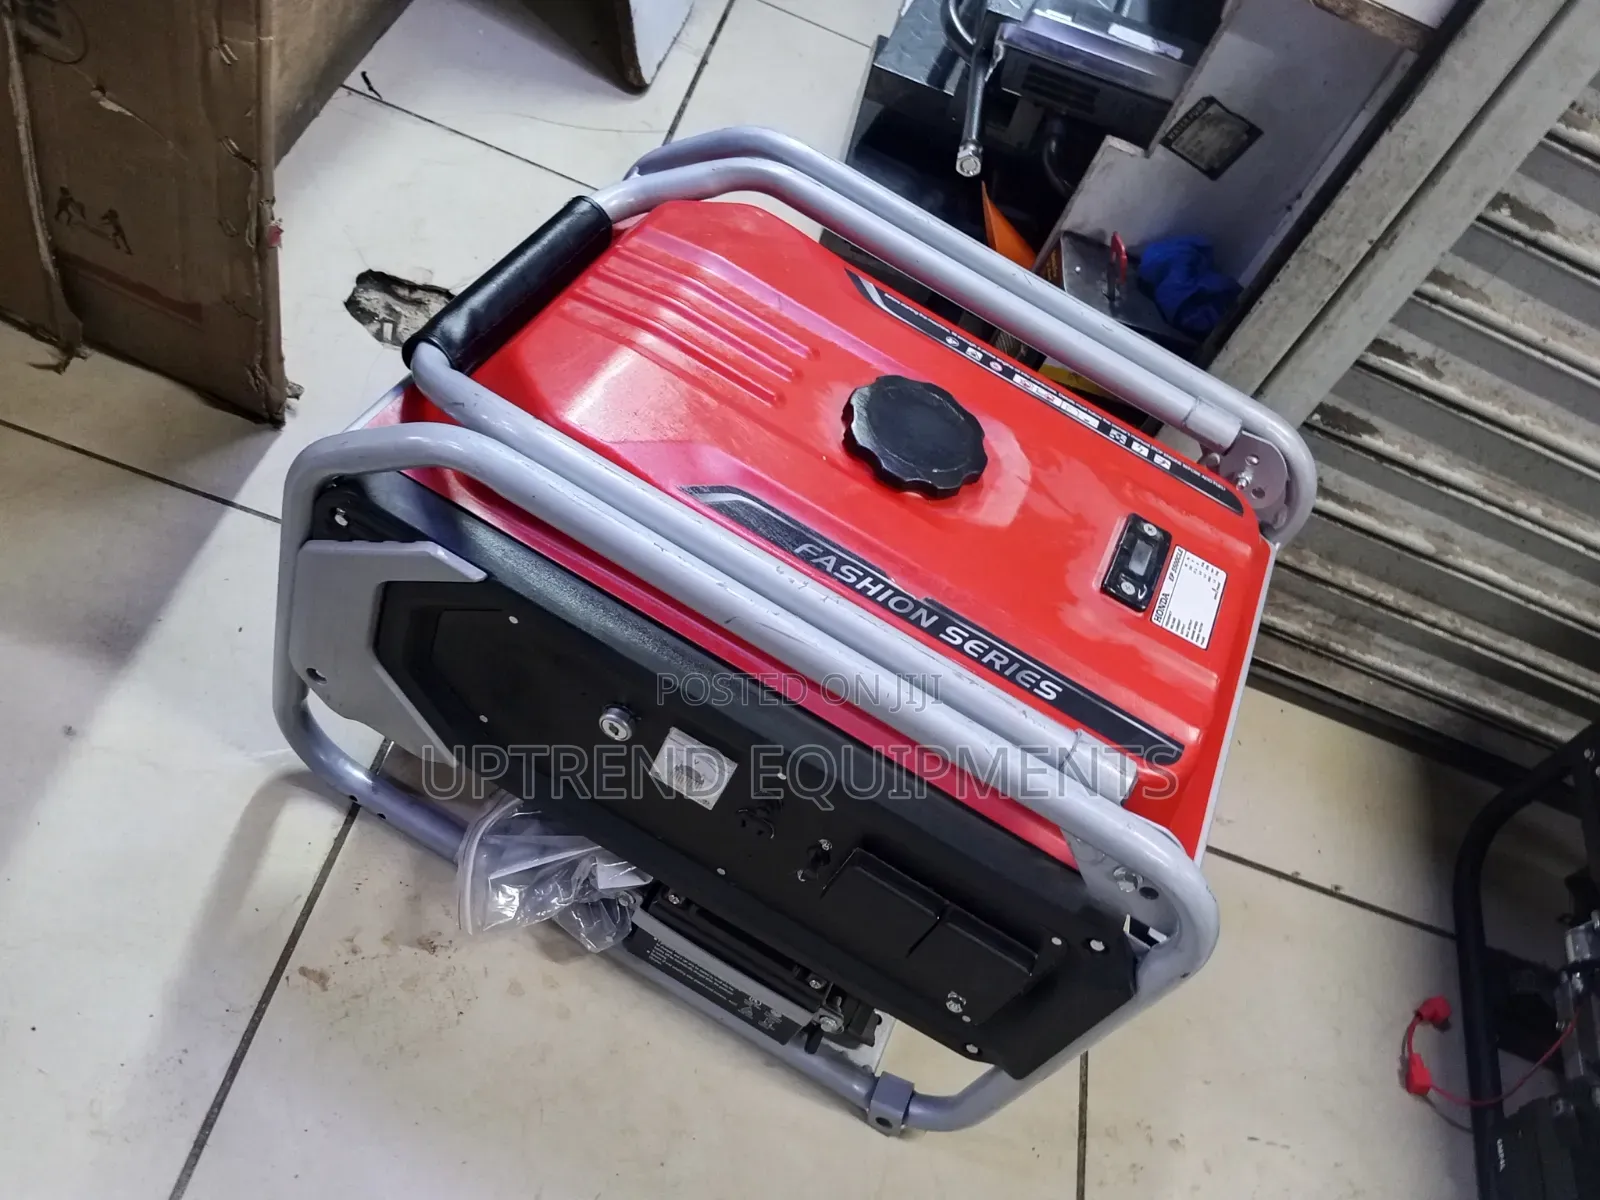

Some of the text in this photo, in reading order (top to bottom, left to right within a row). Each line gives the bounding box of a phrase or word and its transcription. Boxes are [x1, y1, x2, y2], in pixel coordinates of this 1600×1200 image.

[795, 543, 1062, 700] FASHION SERIES
[1154, 592, 1170, 623] HONDA
